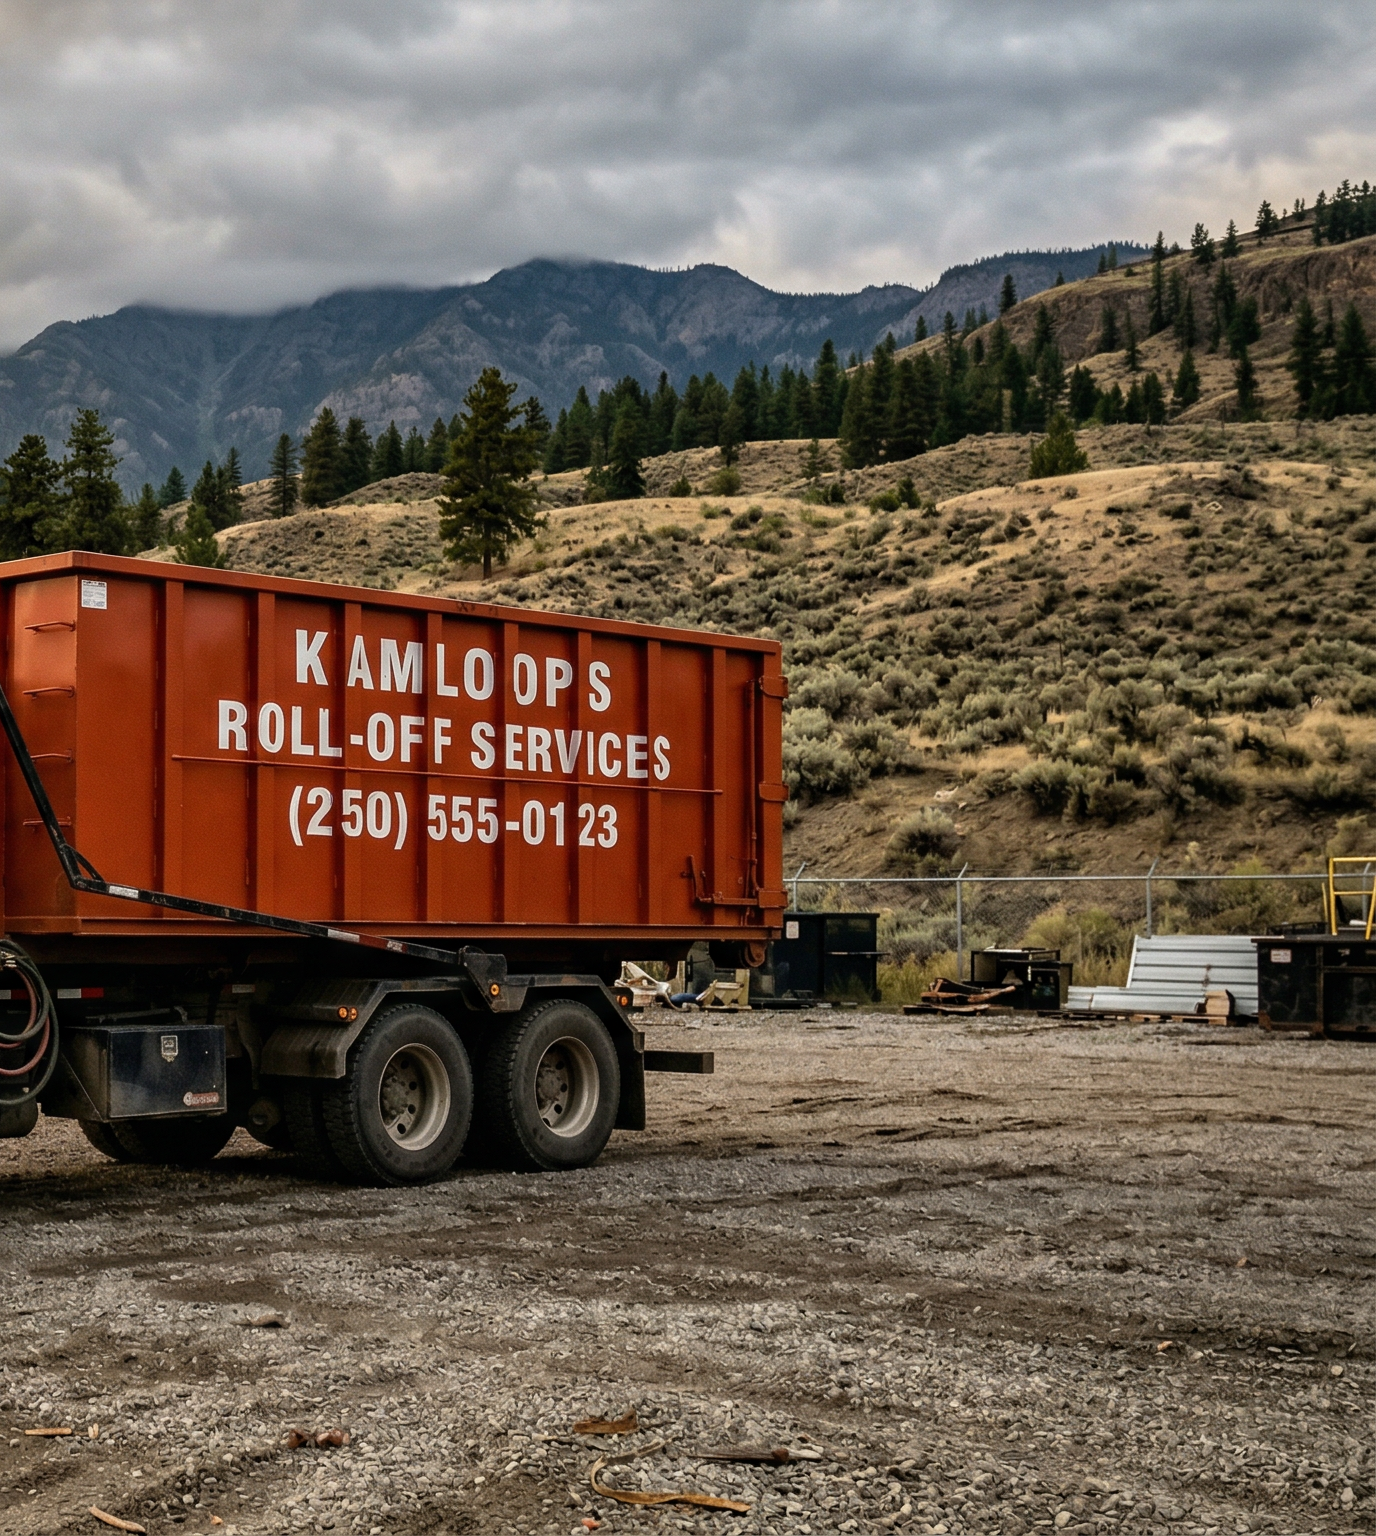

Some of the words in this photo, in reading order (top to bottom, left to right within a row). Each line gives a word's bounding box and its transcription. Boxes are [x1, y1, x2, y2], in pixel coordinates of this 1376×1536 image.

[295, 629, 612, 712] KAMLOOPS
[218, 699, 452, 764] ROLL-OFF
[471, 721, 671, 781] SERVICES
[289, 785, 408, 850] (250)
[427, 794, 619, 848] 555-0123
